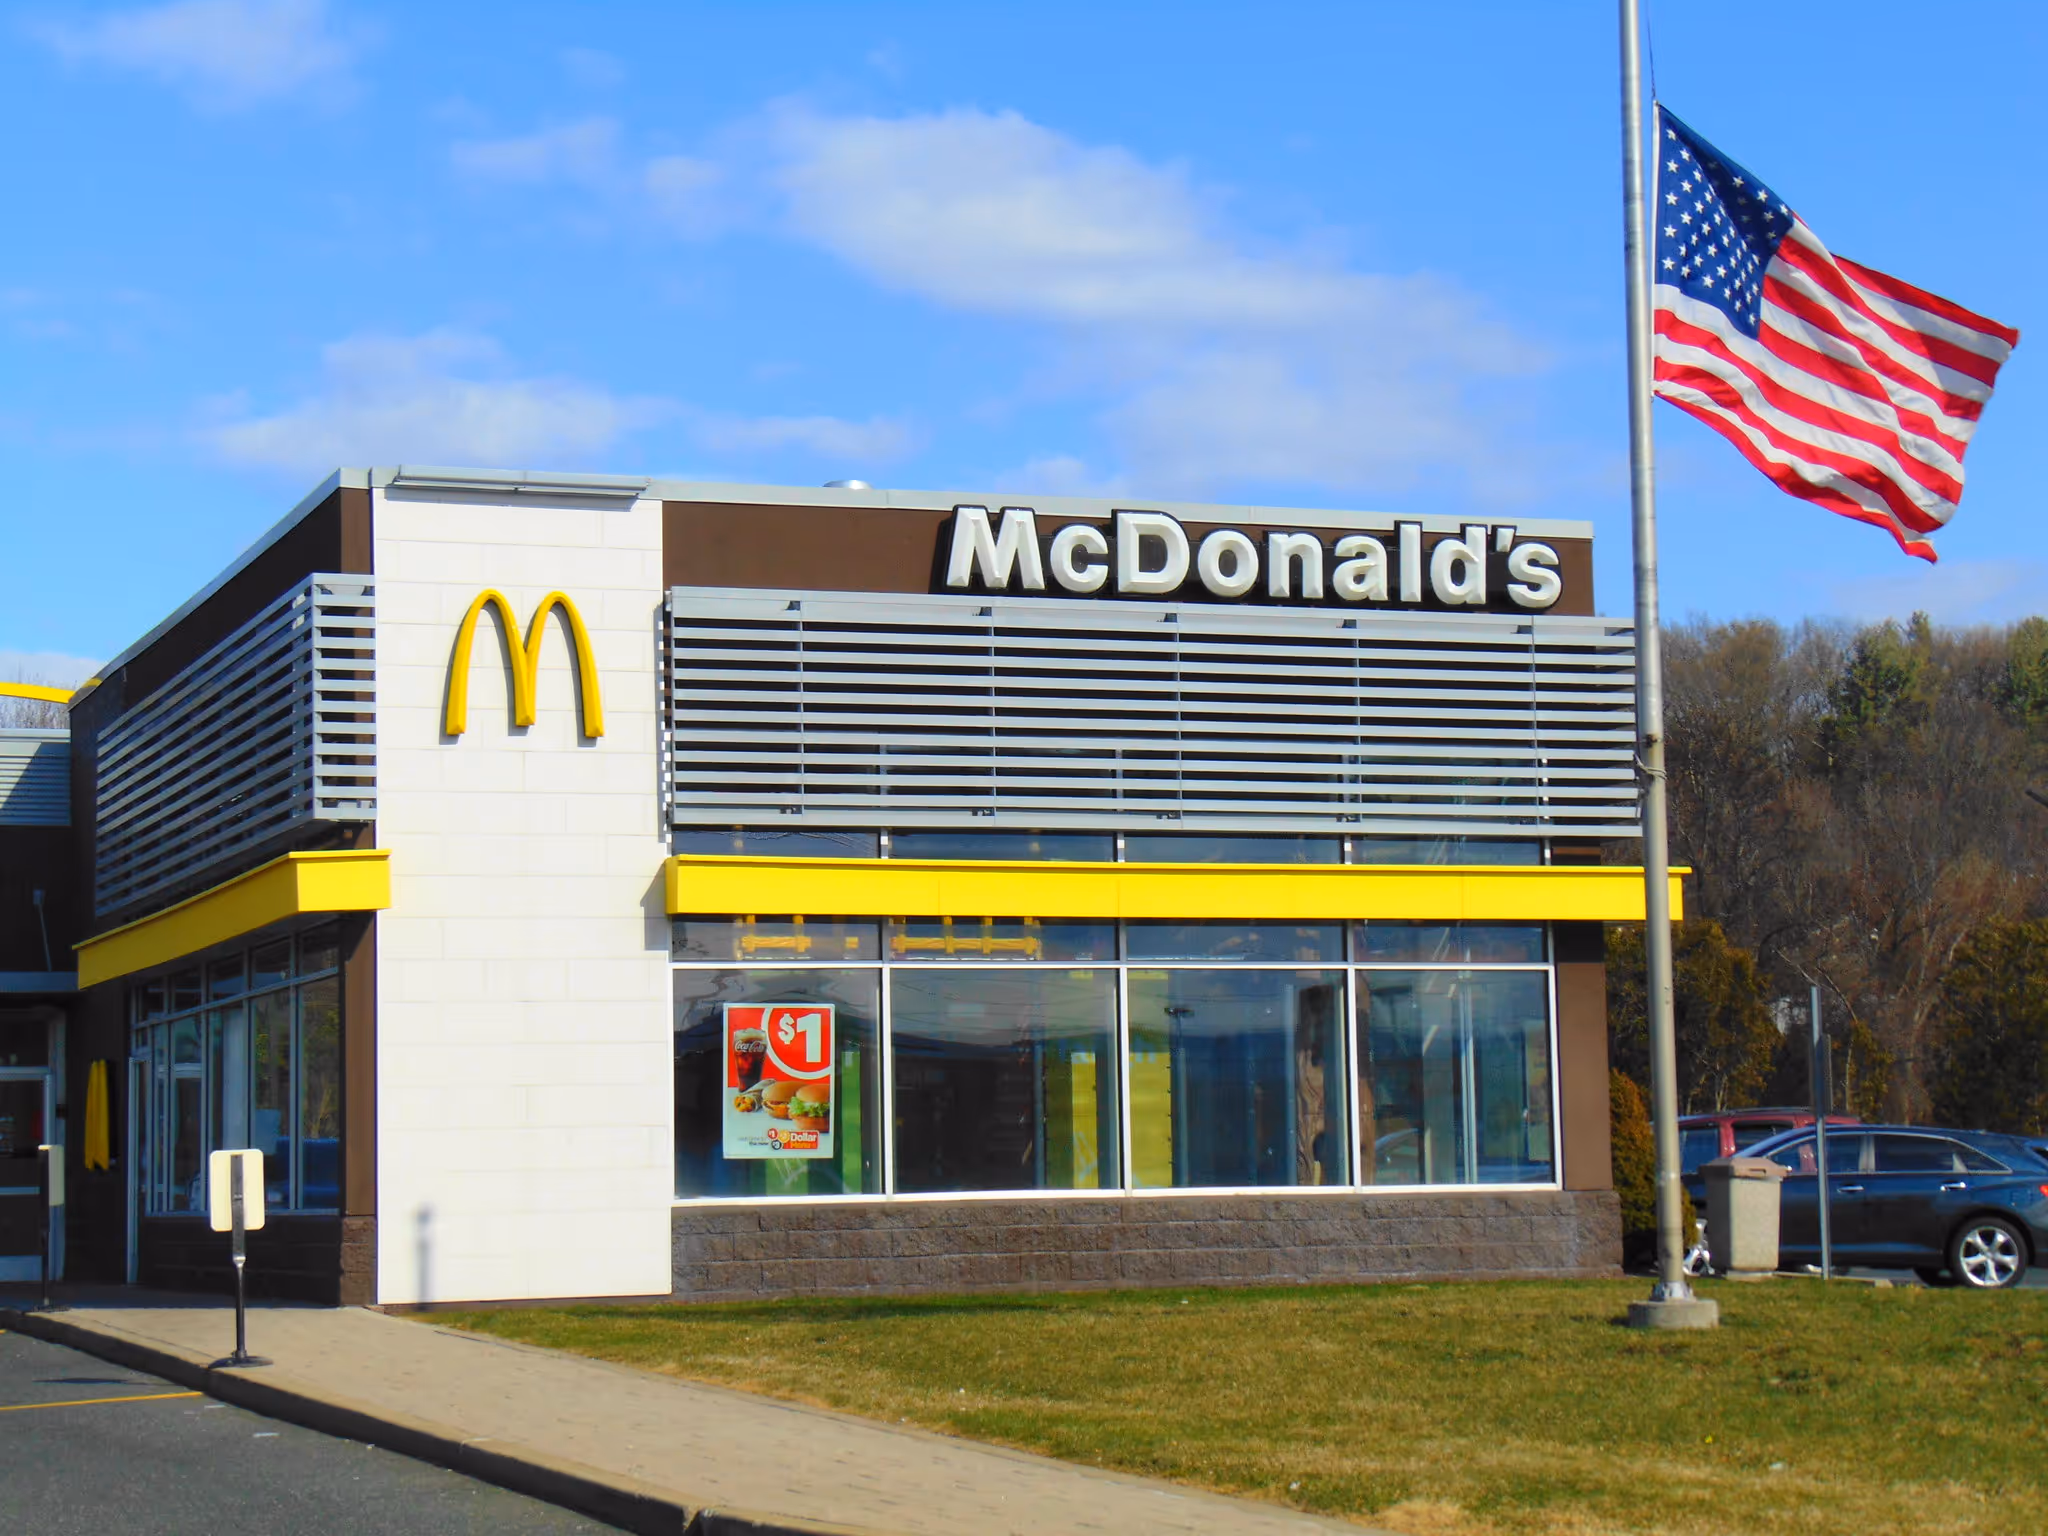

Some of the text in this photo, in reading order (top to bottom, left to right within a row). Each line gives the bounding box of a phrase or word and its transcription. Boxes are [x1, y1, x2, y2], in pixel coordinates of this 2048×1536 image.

[947, 506, 1563, 608] McDonald's
[446, 588, 605, 738] M
[778, 1013, 822, 1063] $1
[790, 1133, 817, 1142] Dollar
